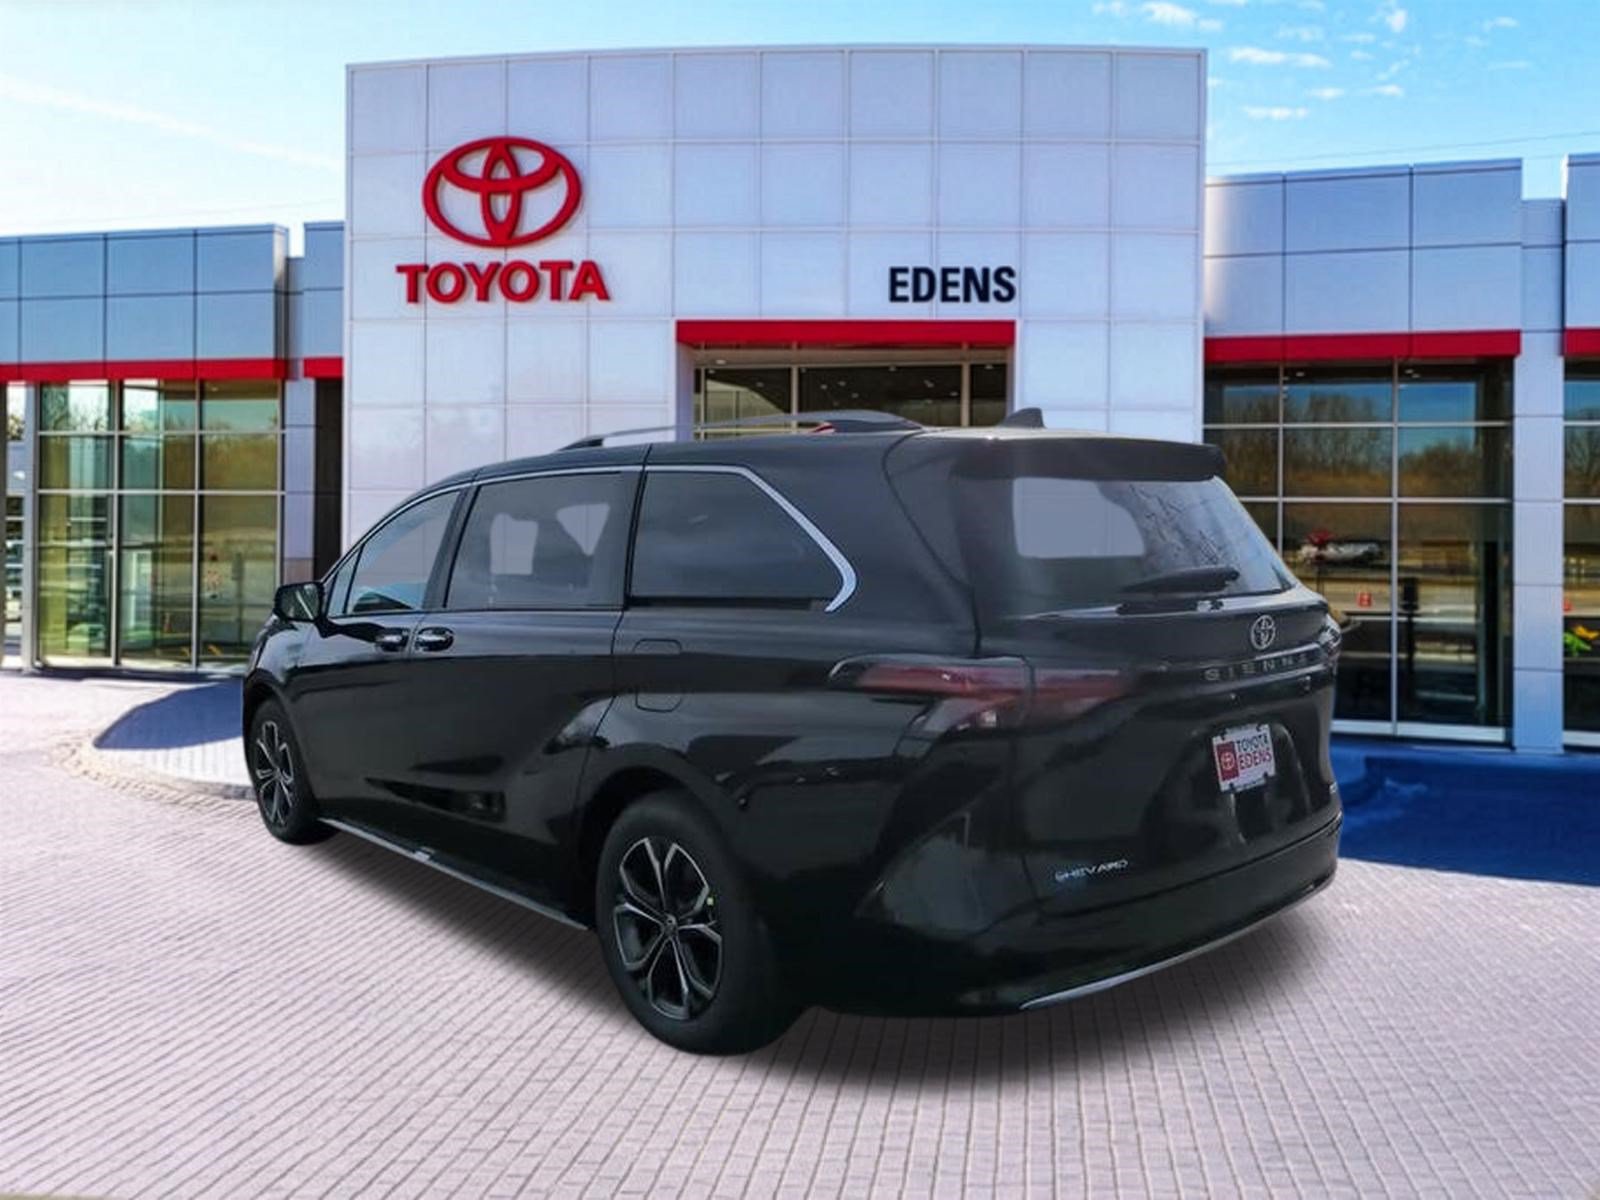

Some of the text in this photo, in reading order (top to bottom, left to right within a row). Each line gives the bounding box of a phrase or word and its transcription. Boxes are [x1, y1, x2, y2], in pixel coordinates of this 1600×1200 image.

[396, 260, 611, 303] TOYOTA
[889, 266, 1016, 303] EDENS
[1238, 747, 1272, 769] EDENS
